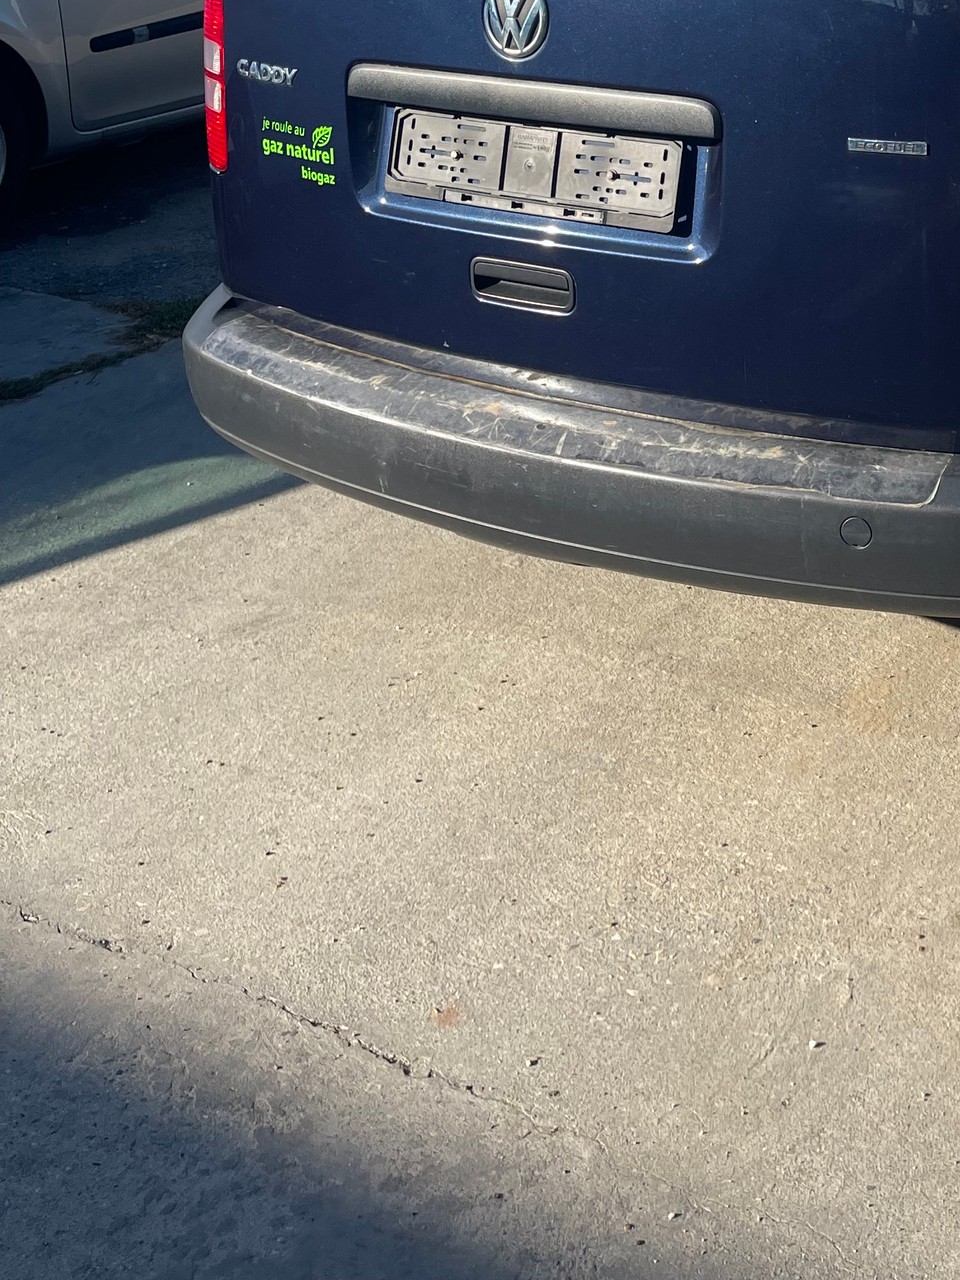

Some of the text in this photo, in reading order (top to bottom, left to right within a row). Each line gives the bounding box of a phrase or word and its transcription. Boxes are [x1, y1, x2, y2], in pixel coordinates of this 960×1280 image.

[236, 58, 298, 86] CADDY
[262, 116, 306, 137] je roule au
[262, 138, 335, 165] gaz naturel
[301, 165, 336, 186] biogaz
